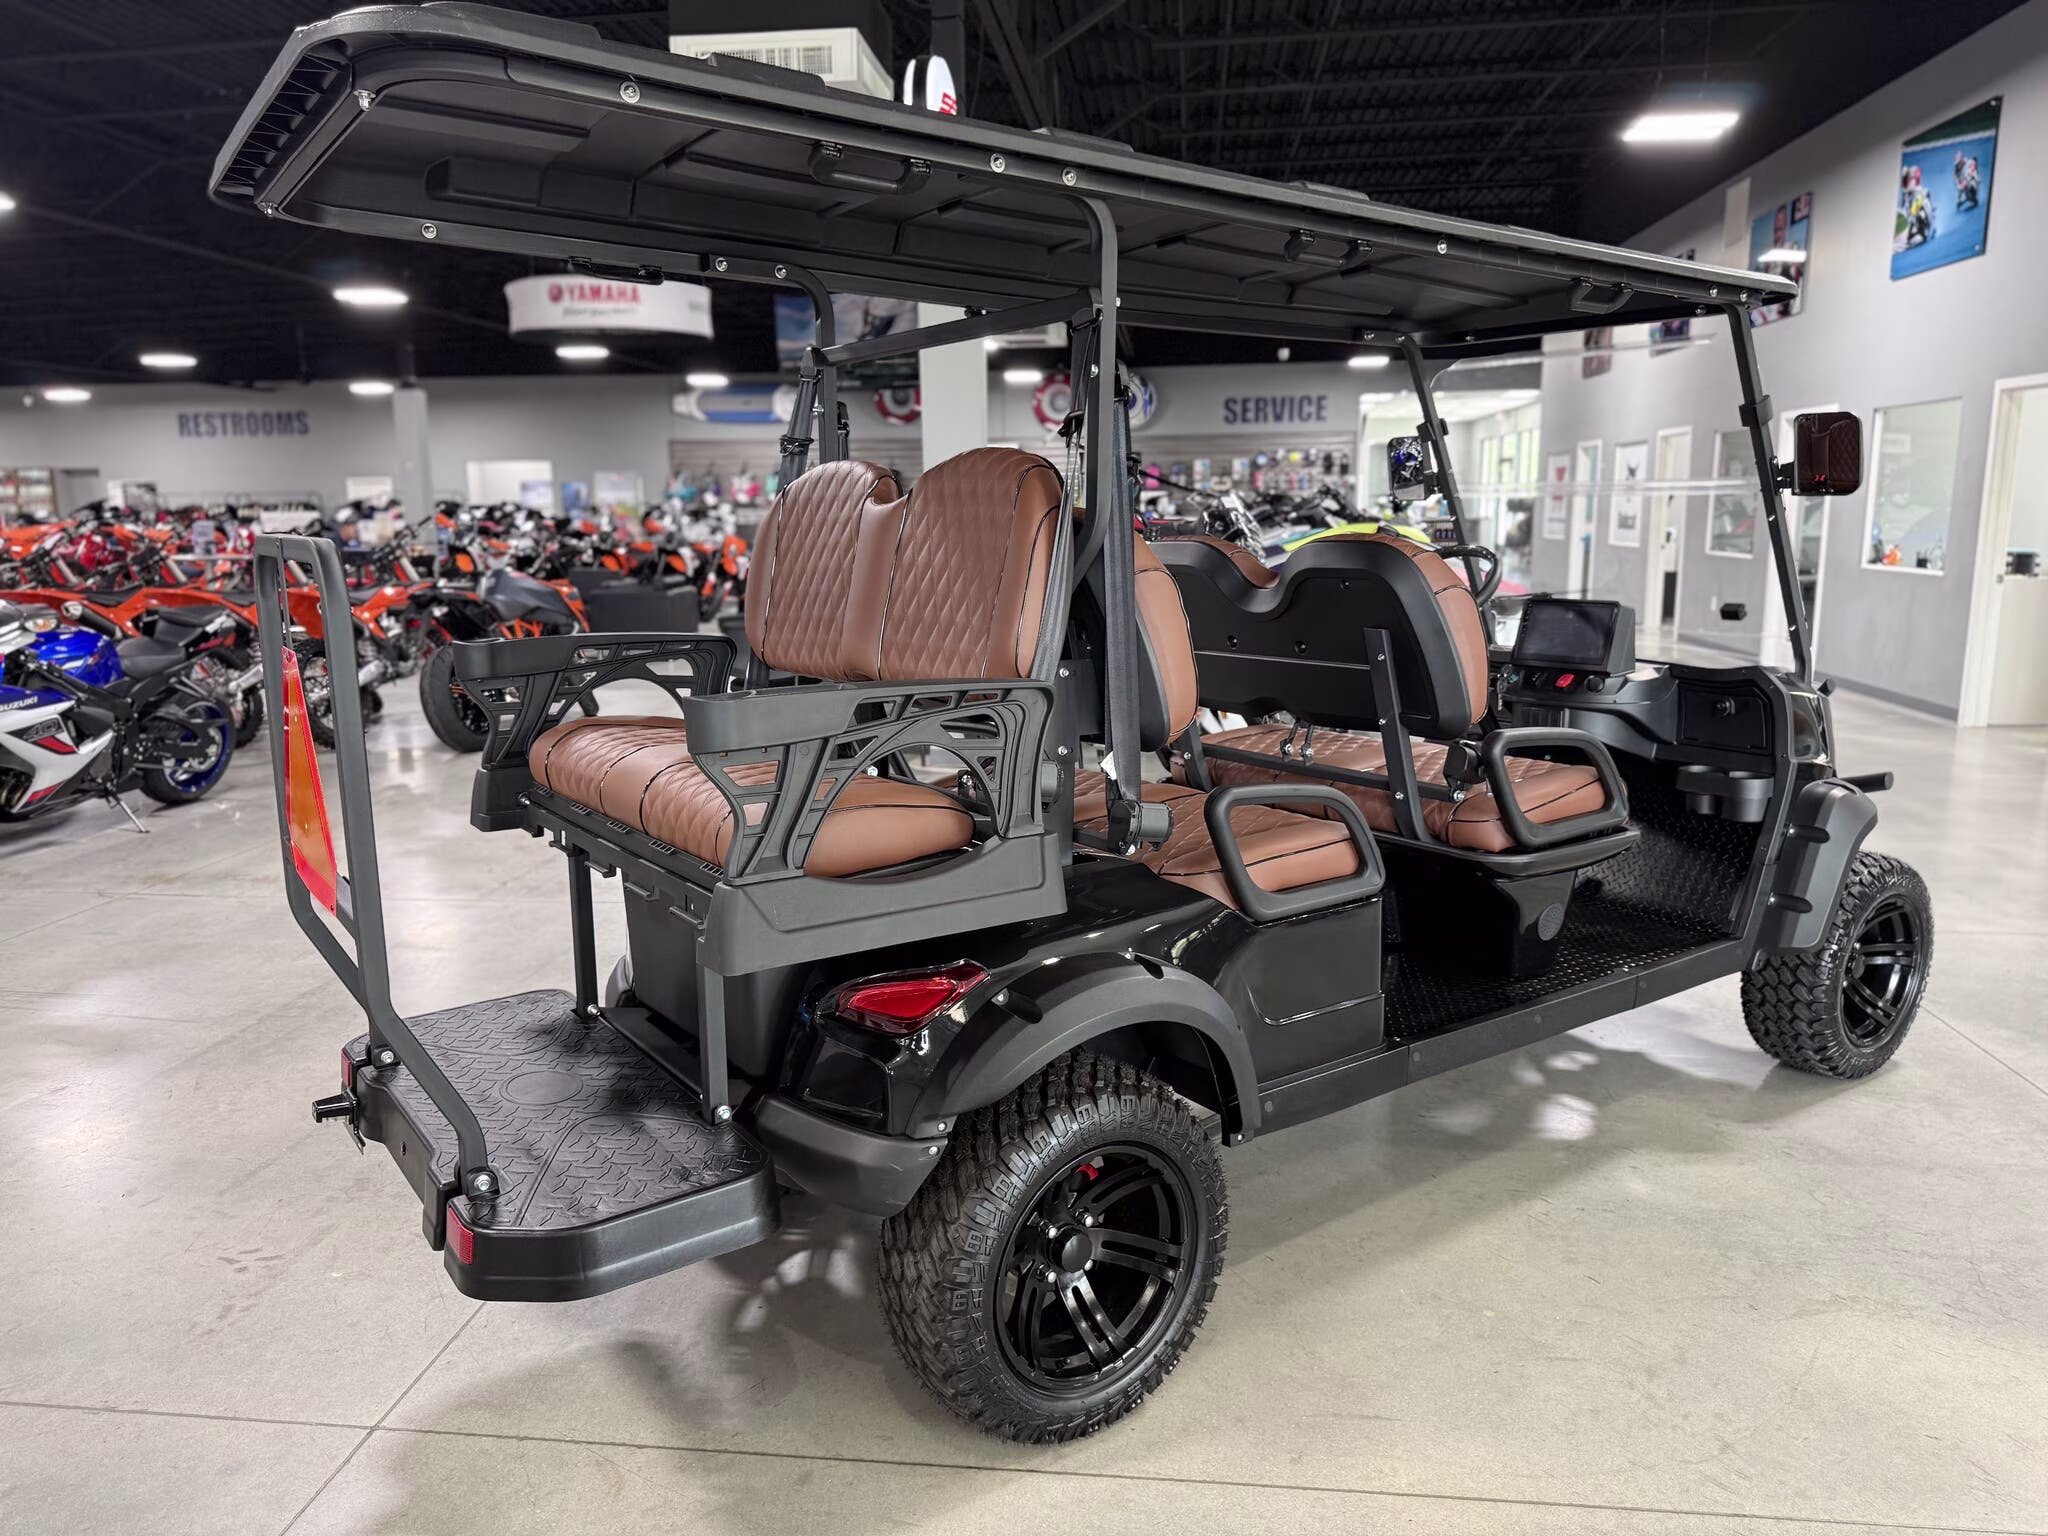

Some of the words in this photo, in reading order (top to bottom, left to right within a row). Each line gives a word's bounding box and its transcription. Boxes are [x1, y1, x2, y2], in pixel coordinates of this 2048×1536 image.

[567, 284, 640, 302] YAMAHA
[1223, 395, 1328, 425] SERVICE
[178, 411, 309, 437] RESTROOMS
